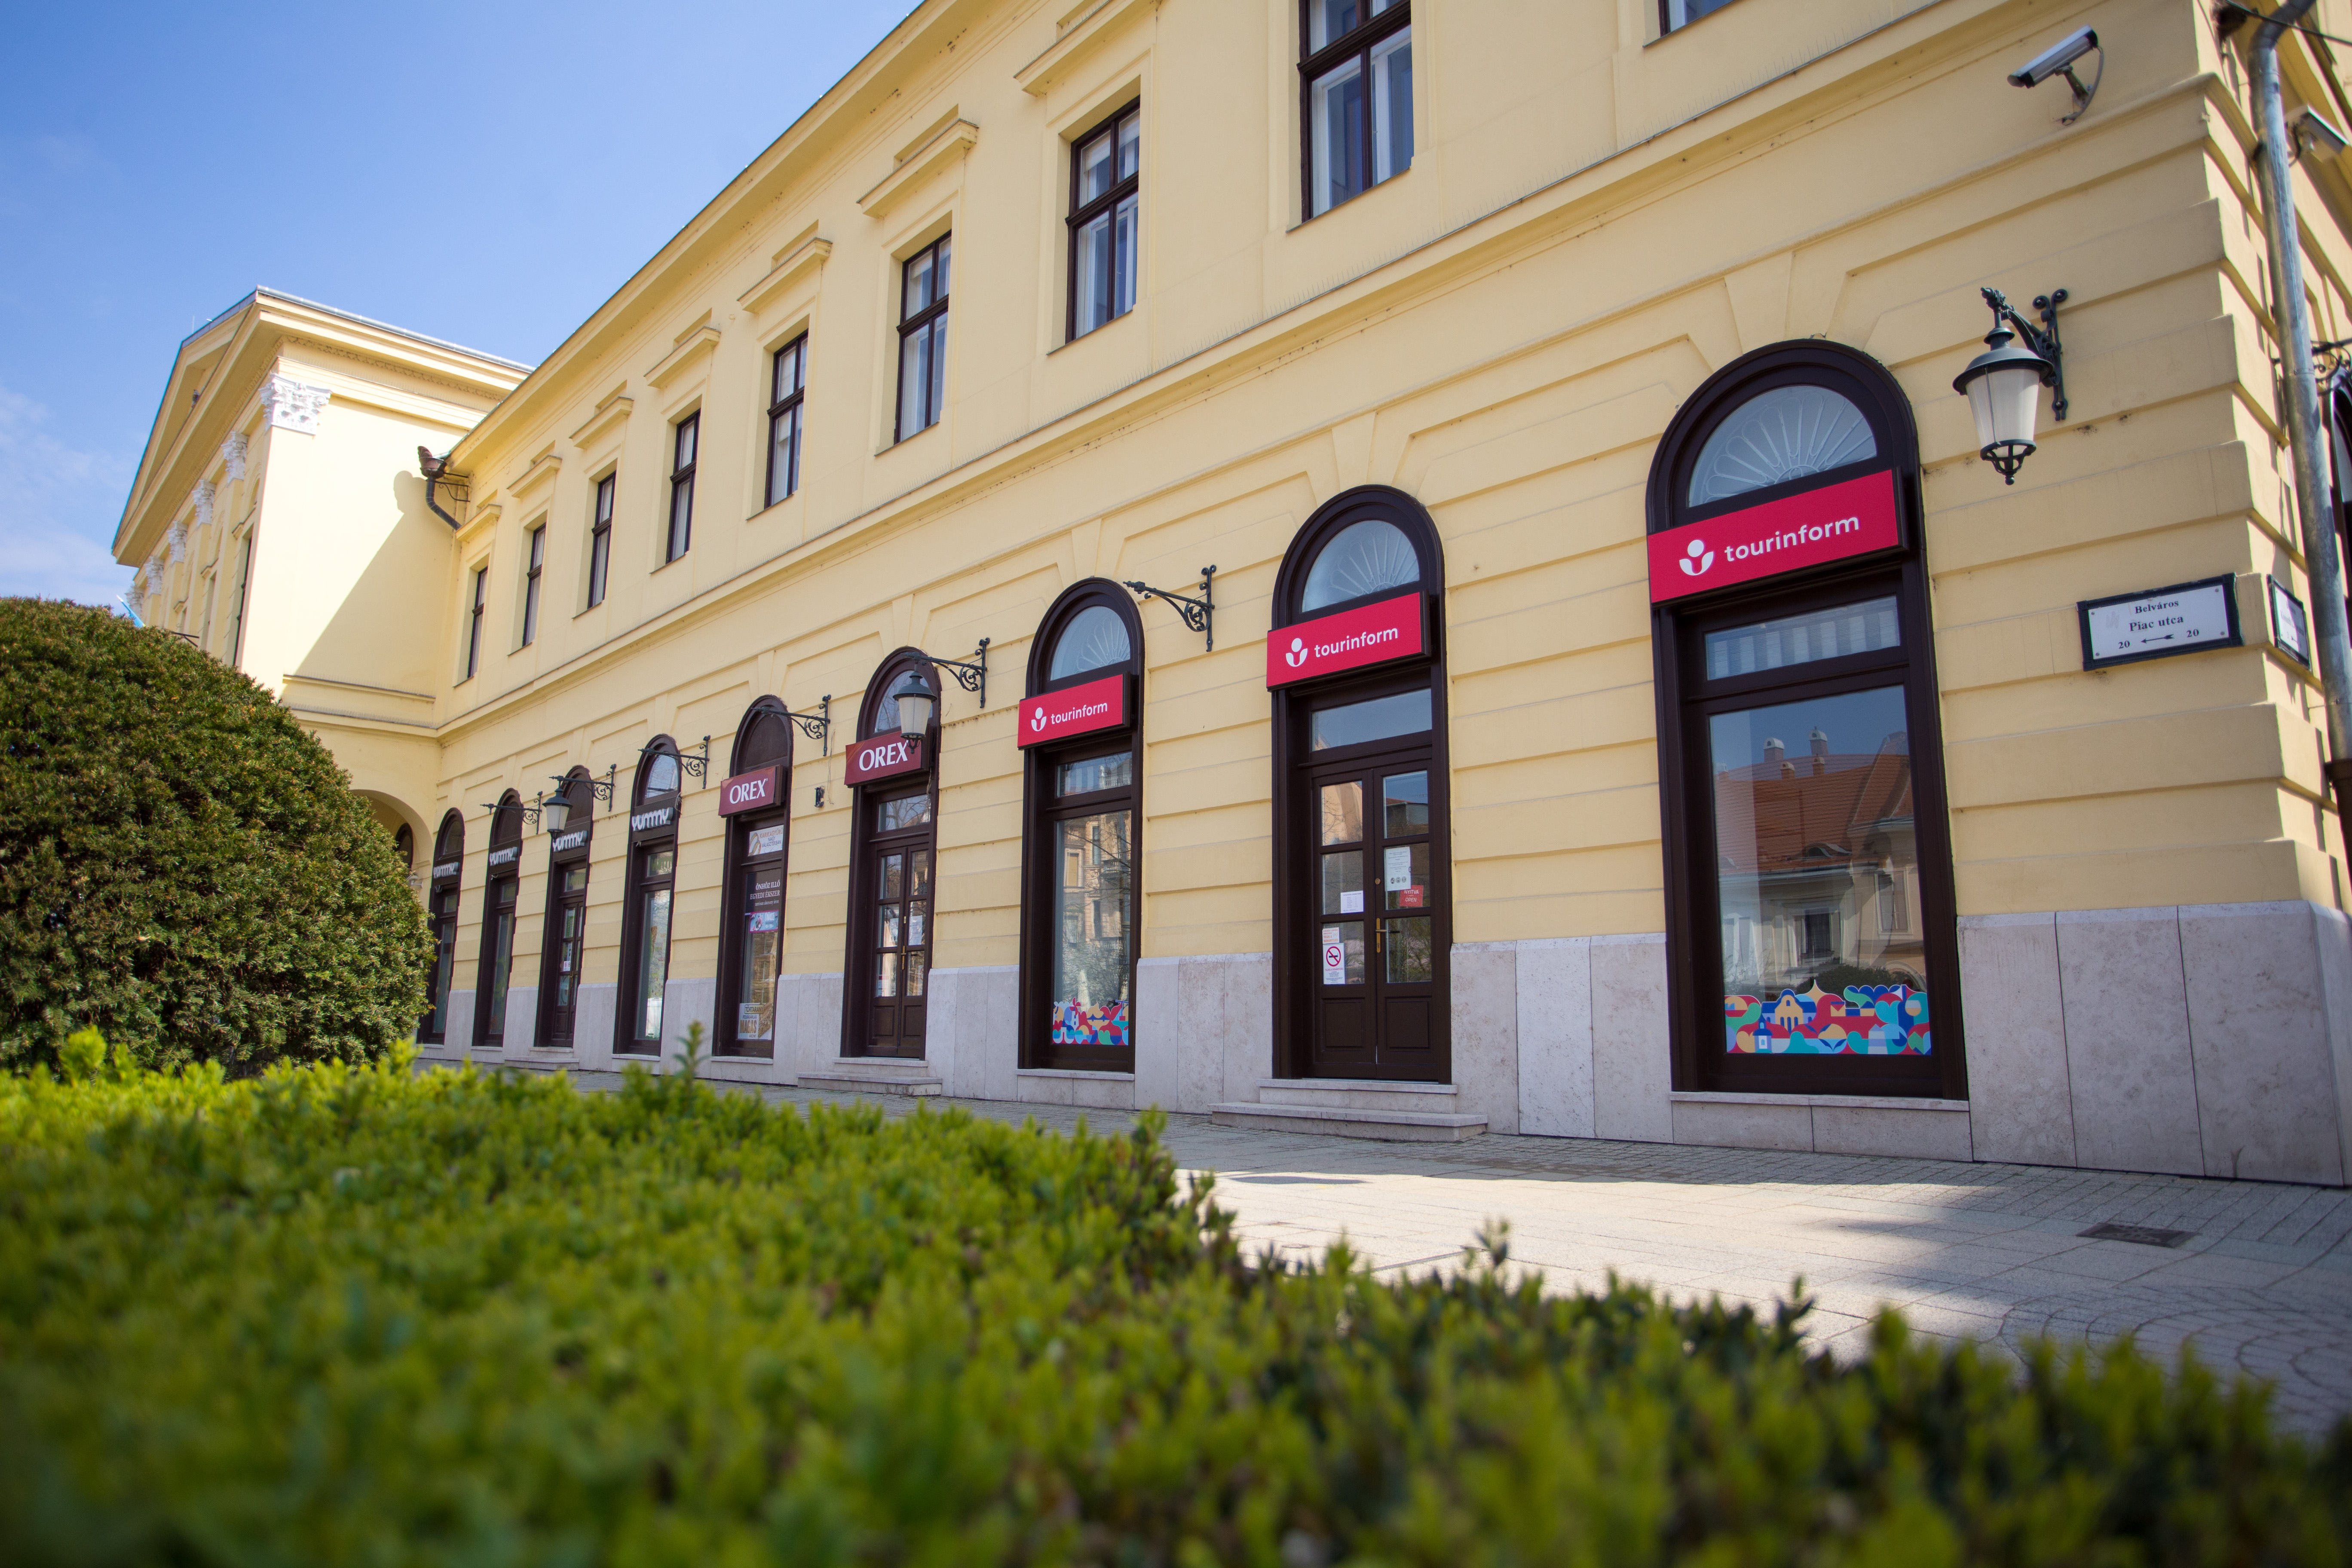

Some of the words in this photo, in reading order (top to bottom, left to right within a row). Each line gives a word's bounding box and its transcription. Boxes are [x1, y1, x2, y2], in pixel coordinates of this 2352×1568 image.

[1724, 517, 1859, 562] tourinform
[2135, 601, 2179, 614] Belváros
[2129, 623, 2154, 632] Piac
[2158, 616, 2184, 626] utca
[1314, 628, 1398, 658] tourinform
[2118, 640, 2130, 649] 20
[2186, 629, 2199, 638] 20
[1051, 702, 1108, 725] tourinform
[859, 740, 909, 771] OREX
[740, 1020, 757, 1033] MAGAS
